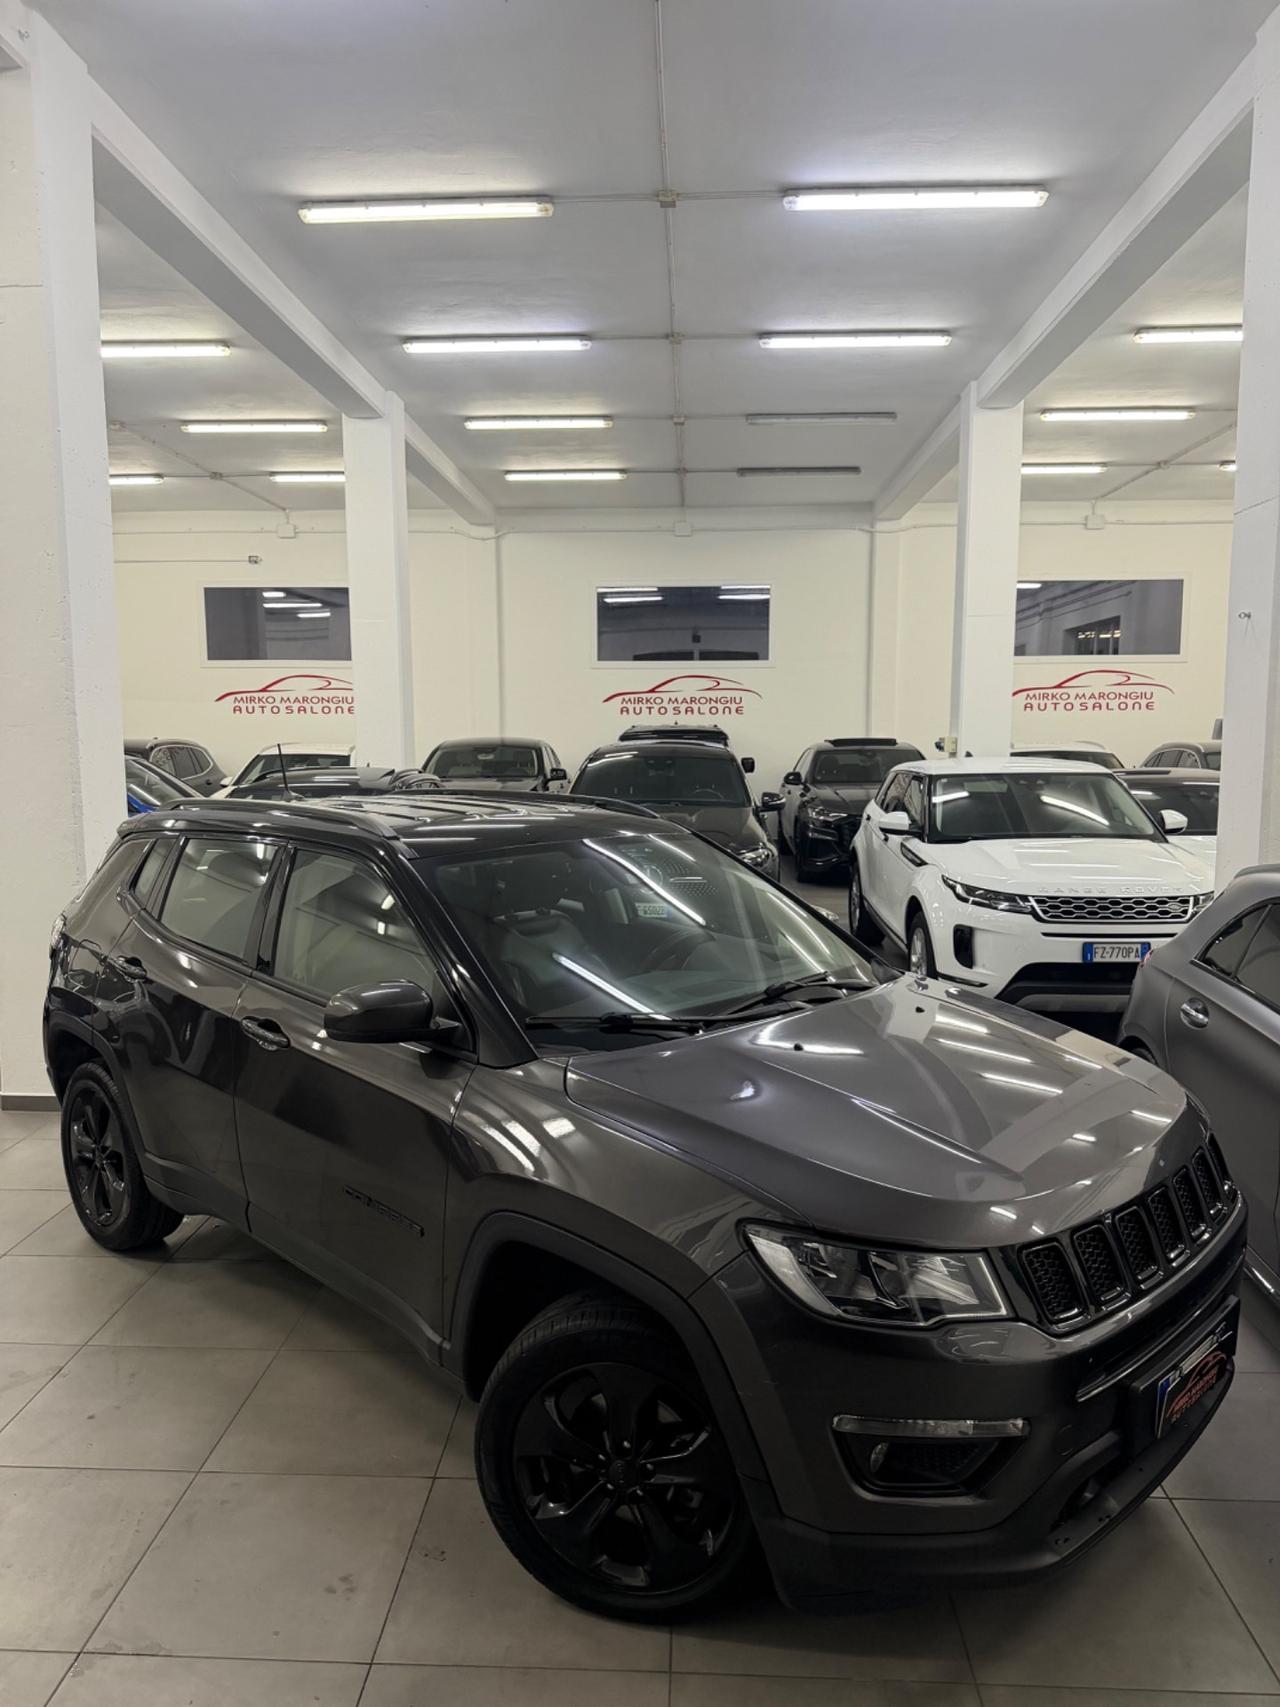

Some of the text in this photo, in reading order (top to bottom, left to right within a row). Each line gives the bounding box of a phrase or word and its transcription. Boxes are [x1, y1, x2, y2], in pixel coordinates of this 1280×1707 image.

[233, 696, 354, 704] MIRKO MARONGIU
[621, 696, 743, 705] MIRKO MARONGIU
[1025, 691, 1154, 701] MIRKO MARONGIU
[233, 705, 355, 715] AUTOSALONE
[620, 706, 744, 715] AUTOSALONE
[1024, 701, 1155, 712] AUTOSALONE
[1038, 886, 1185, 895] RANGE ROVER
